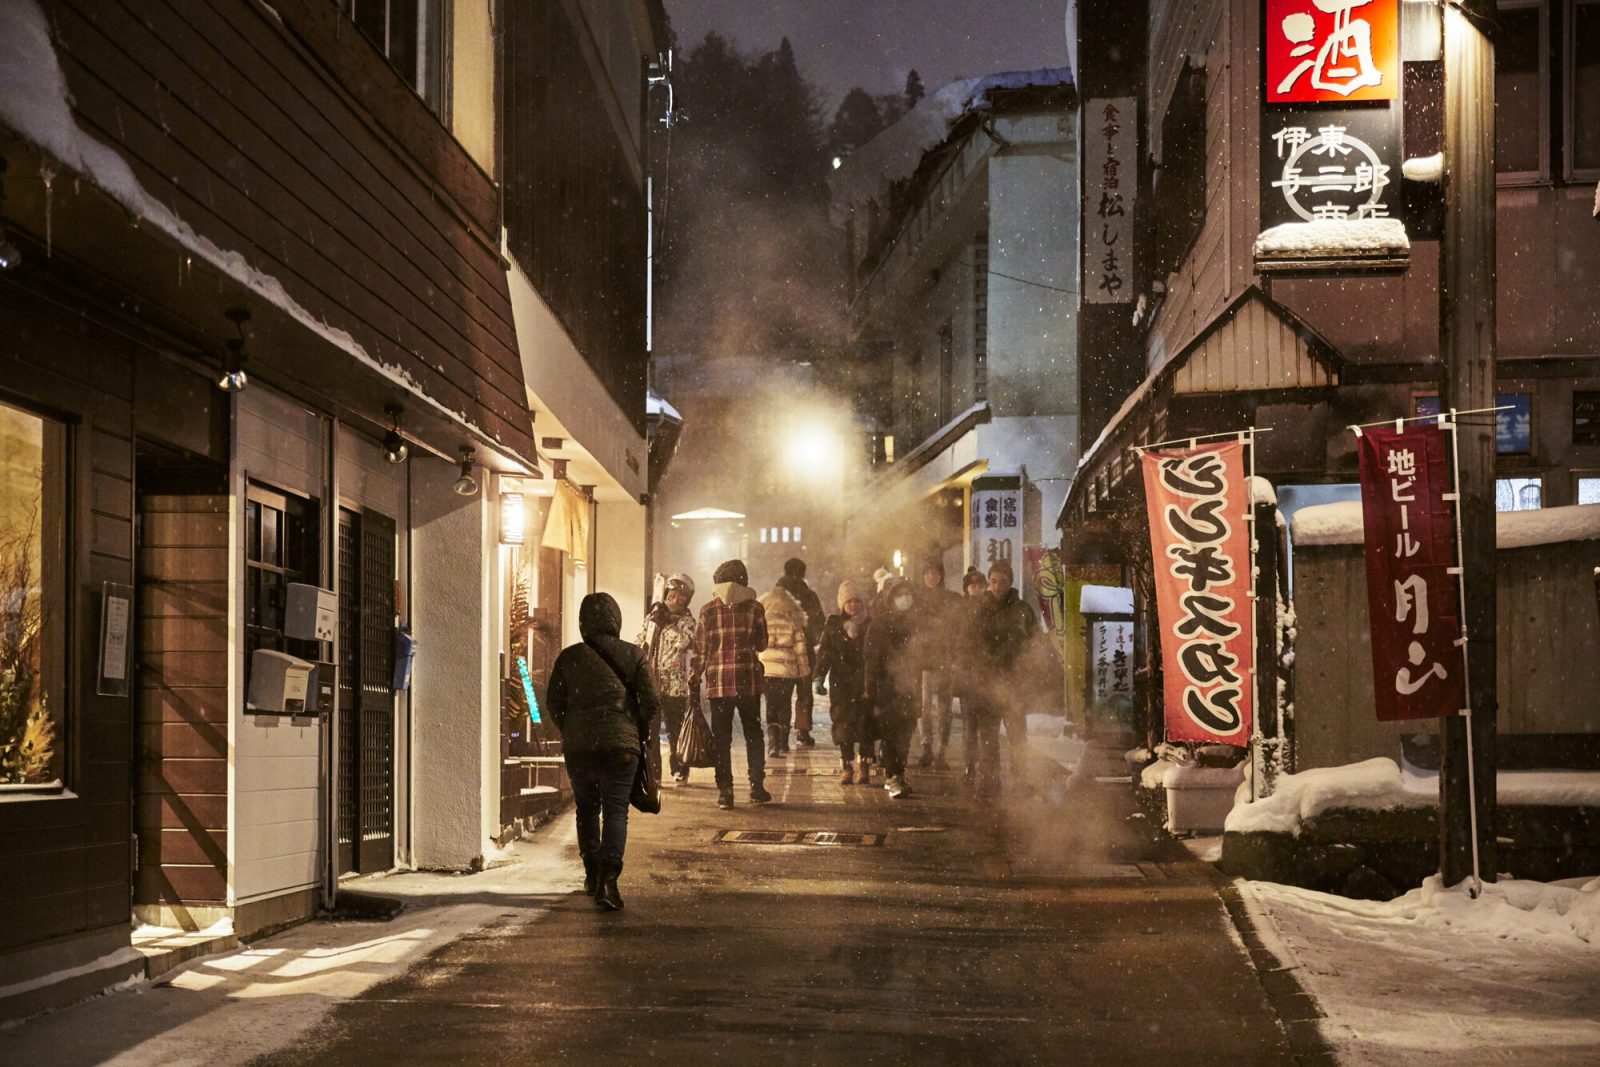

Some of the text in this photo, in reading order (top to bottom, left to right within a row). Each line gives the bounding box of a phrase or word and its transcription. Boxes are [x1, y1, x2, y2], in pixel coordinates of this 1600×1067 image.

[1276, 0, 1384, 96] 酒
[1271, 124, 1352, 158] 伊東
[1271, 162, 1391, 196] 与三郎
[1098, 103, 1125, 296] 食事と宿泊 松しまや
[1387, 448, 1421, 559] 地ビール
